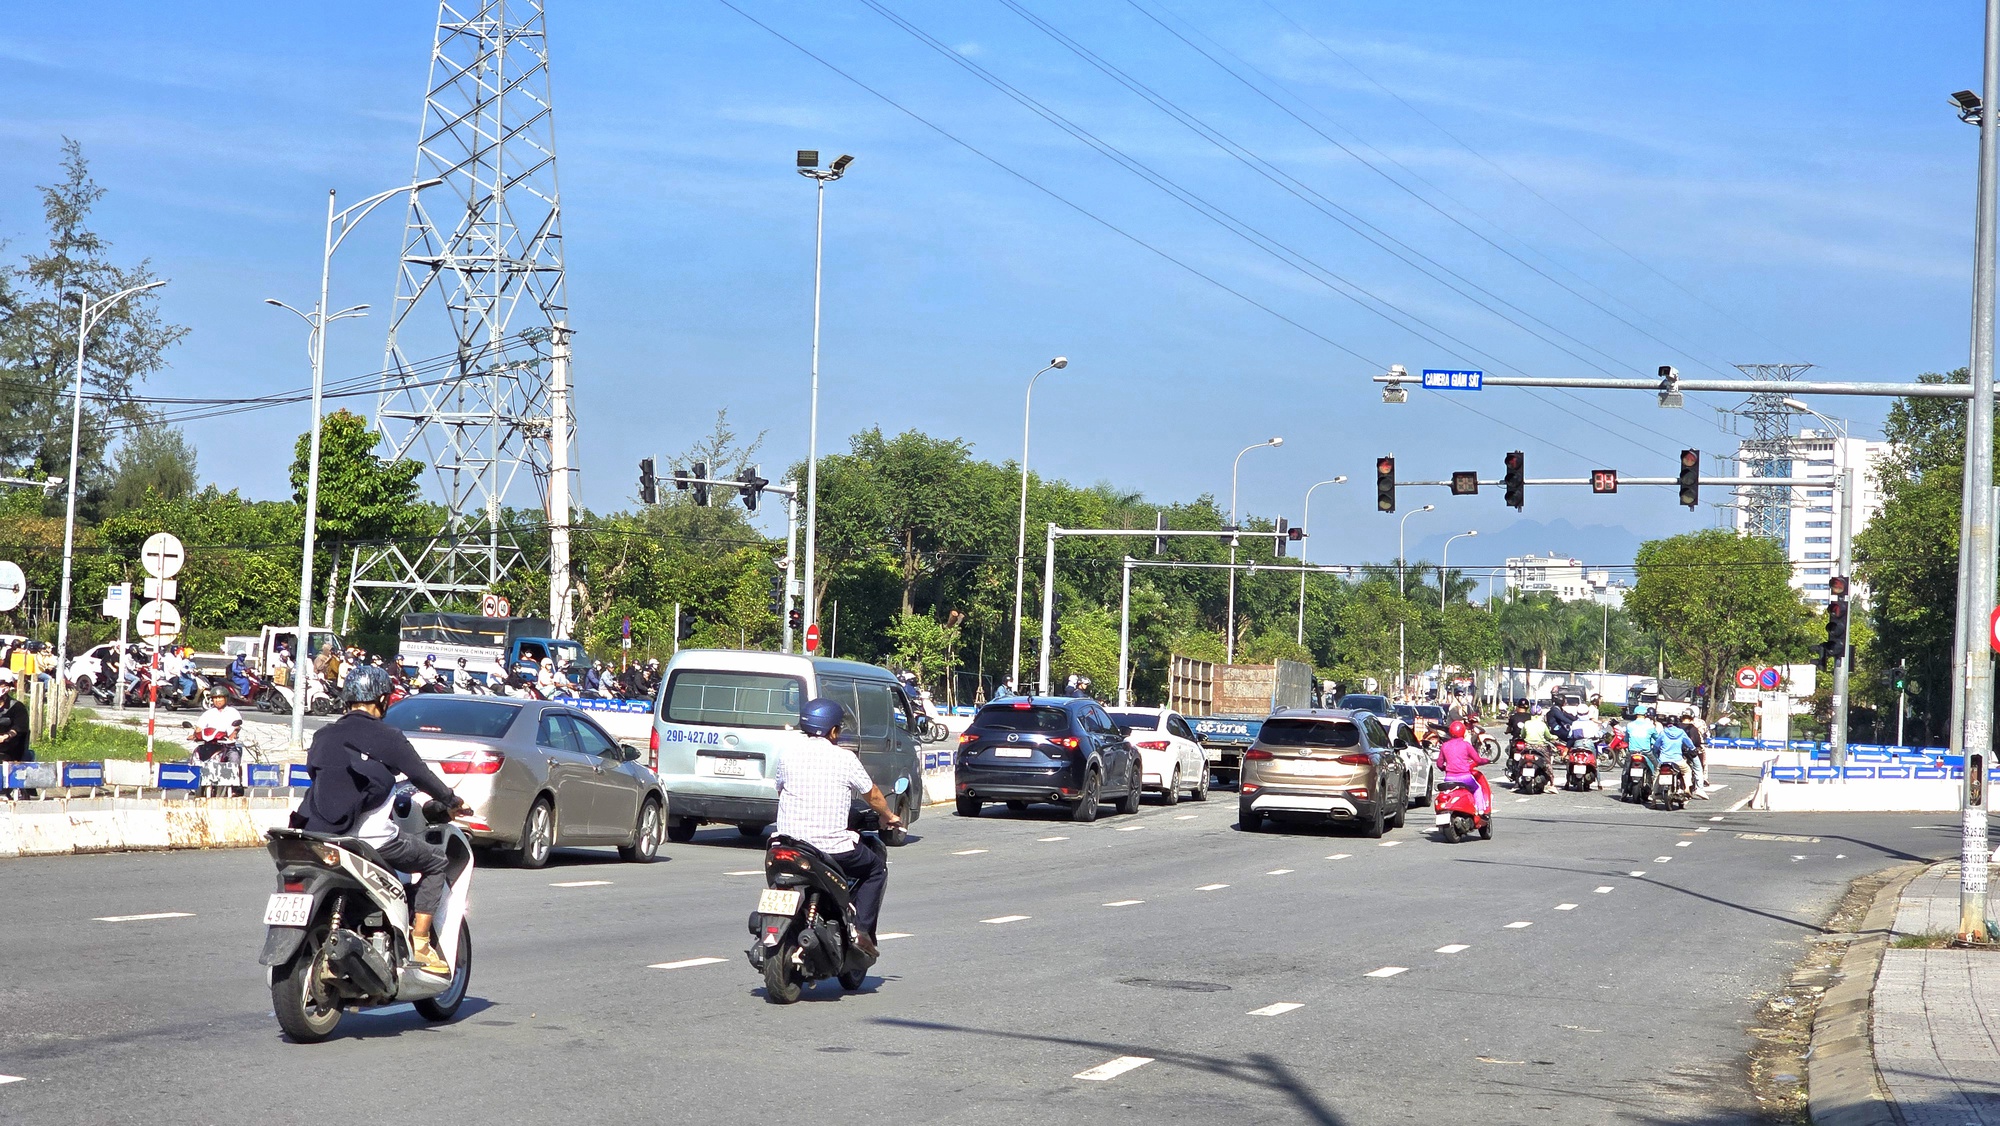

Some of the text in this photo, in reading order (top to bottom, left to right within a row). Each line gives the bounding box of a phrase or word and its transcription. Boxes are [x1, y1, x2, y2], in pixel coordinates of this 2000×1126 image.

[1425, 373, 1450, 386] CAMERA
[667, 730, 719, 745] 29D-427.02
[274, 896, 305, 910] 77-F1
[767, 891, 793, 903] 43-K1
[267, 910, 307, 923] 490.59
